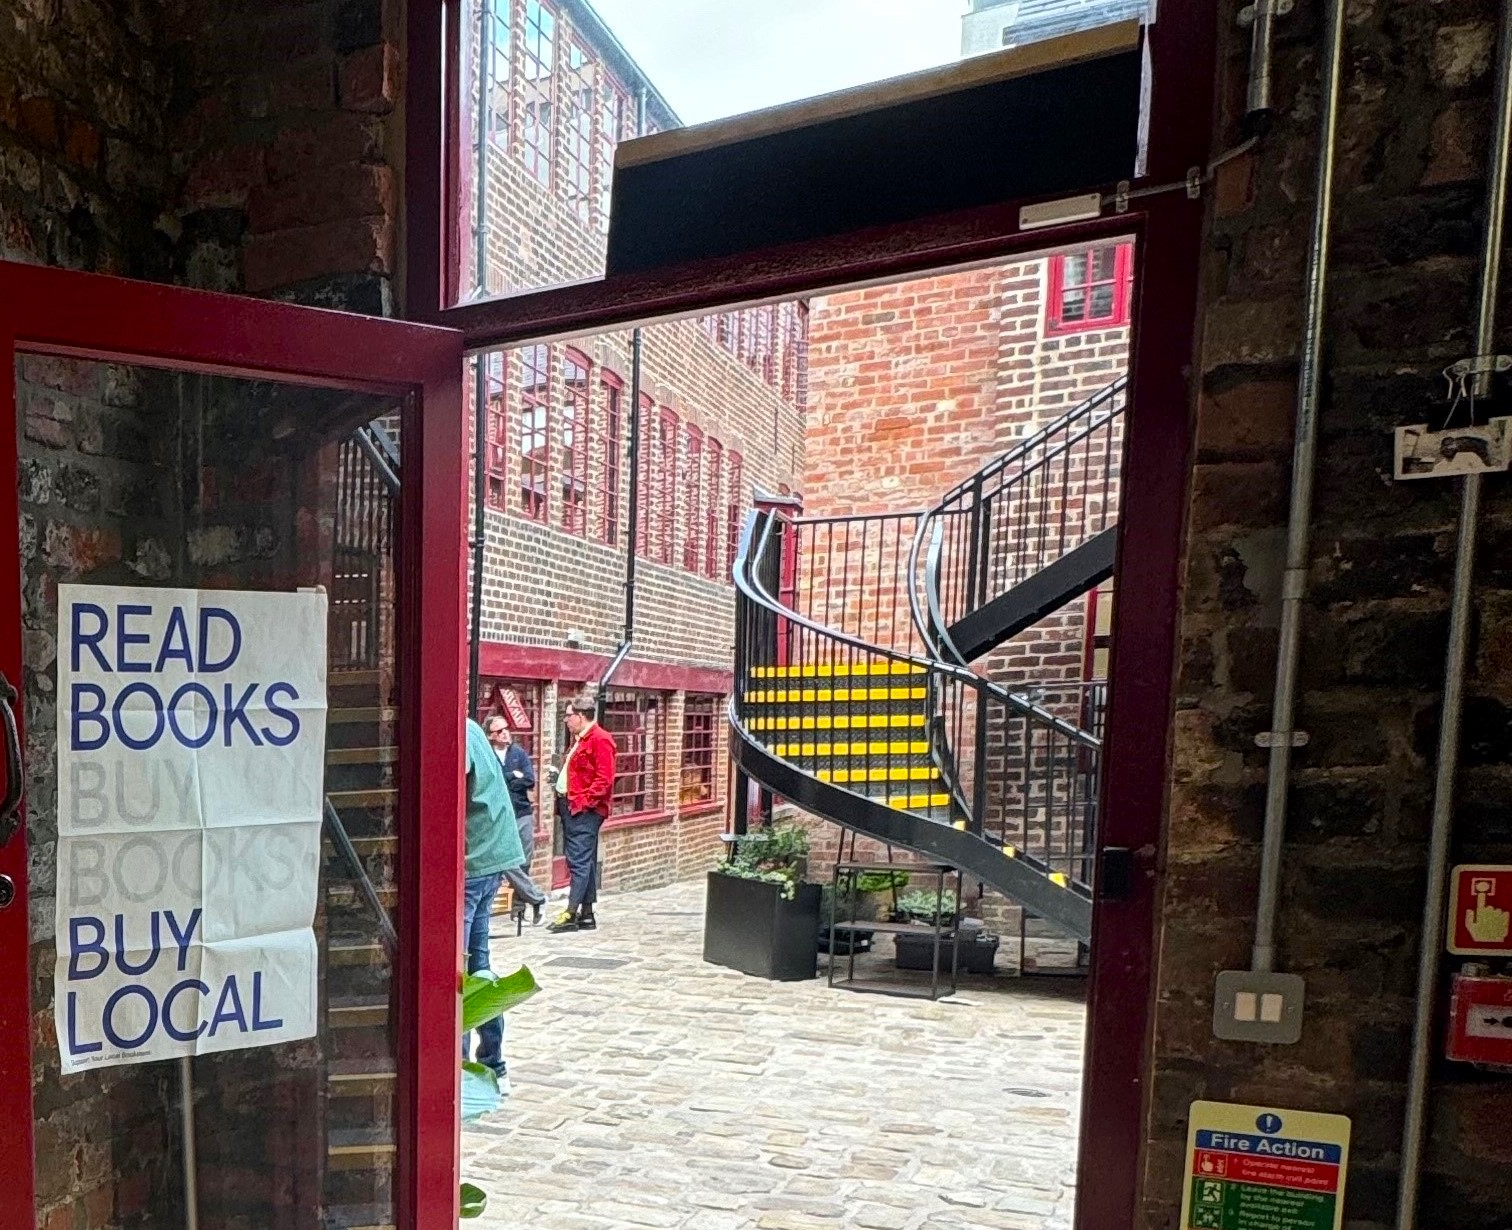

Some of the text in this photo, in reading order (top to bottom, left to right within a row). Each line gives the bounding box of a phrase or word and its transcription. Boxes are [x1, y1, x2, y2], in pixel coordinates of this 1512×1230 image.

[70, 602, 242, 673] READ
[70, 682, 300, 751] BOOKS
[70, 759, 200, 828] BUY
[69, 829, 306, 906] BOOKS
[67, 908, 202, 981] BUY
[67, 971, 283, 1055] LOCAL
[1210, 1133, 1325, 1160] Fire Action
